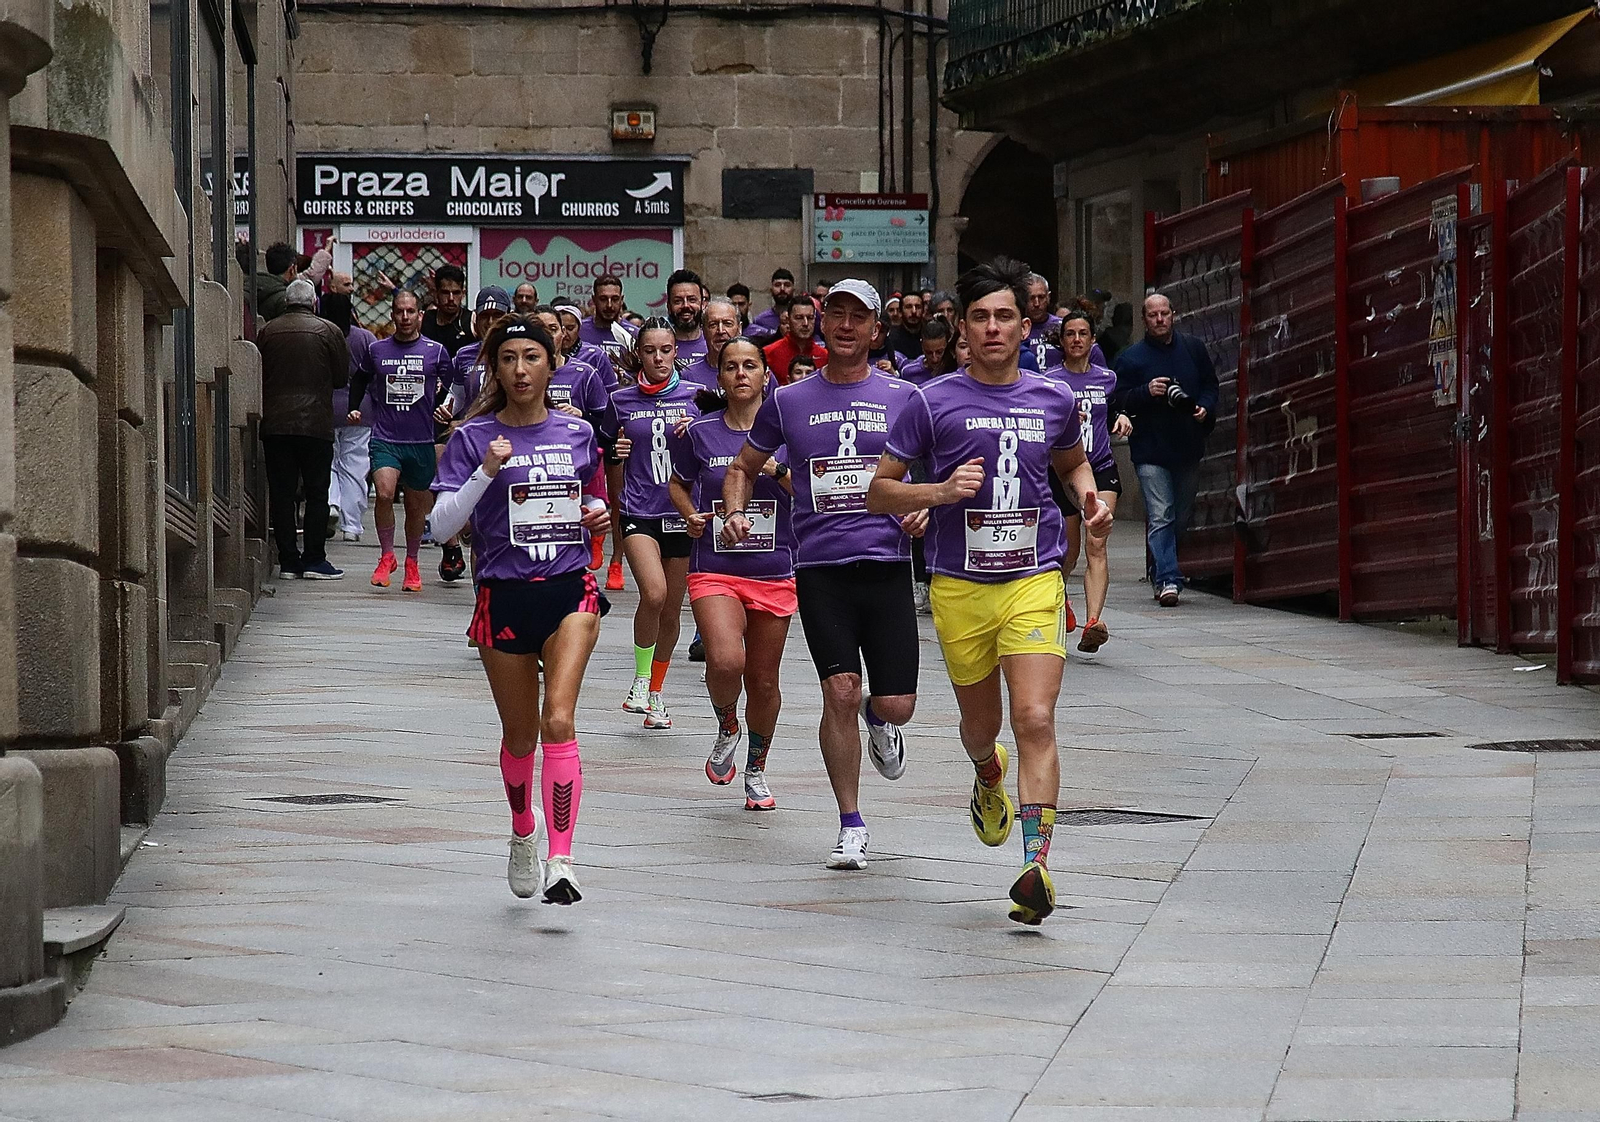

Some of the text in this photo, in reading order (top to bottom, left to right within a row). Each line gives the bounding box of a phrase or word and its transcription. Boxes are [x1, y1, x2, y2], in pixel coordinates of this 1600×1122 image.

[314, 165, 566, 216] Praza Maior
[303, 200, 415, 216] GOFRES & CREPES
[446, 201, 523, 216] CHOCOLATES
[634, 200, 671, 214] A 5mts
[835, 197, 907, 207] Concello de Ourense
[561, 202, 620, 217] CHURROS
[368, 228, 446, 242] iogurladería
[499, 255, 659, 282] iogurladería
[555, 281, 594, 295] Praz
[506, 325, 526, 334] FILA
[630, 410, 655, 421] CARREIRA
[809, 410, 886, 426] CARREIRA DA MULLER
[857, 421, 888, 433] OURENSE
[965, 417, 1045, 431] CARREIRA DA MULLER
[1018, 430, 1046, 443] OURENSE
[533, 453, 545, 465] DA
[545, 453, 573, 465] MULLER
[546, 465, 575, 477] OURENSE
[835, 474, 858, 486] 490
[546, 502, 554, 513] 2
[992, 530, 1017, 542] 576
